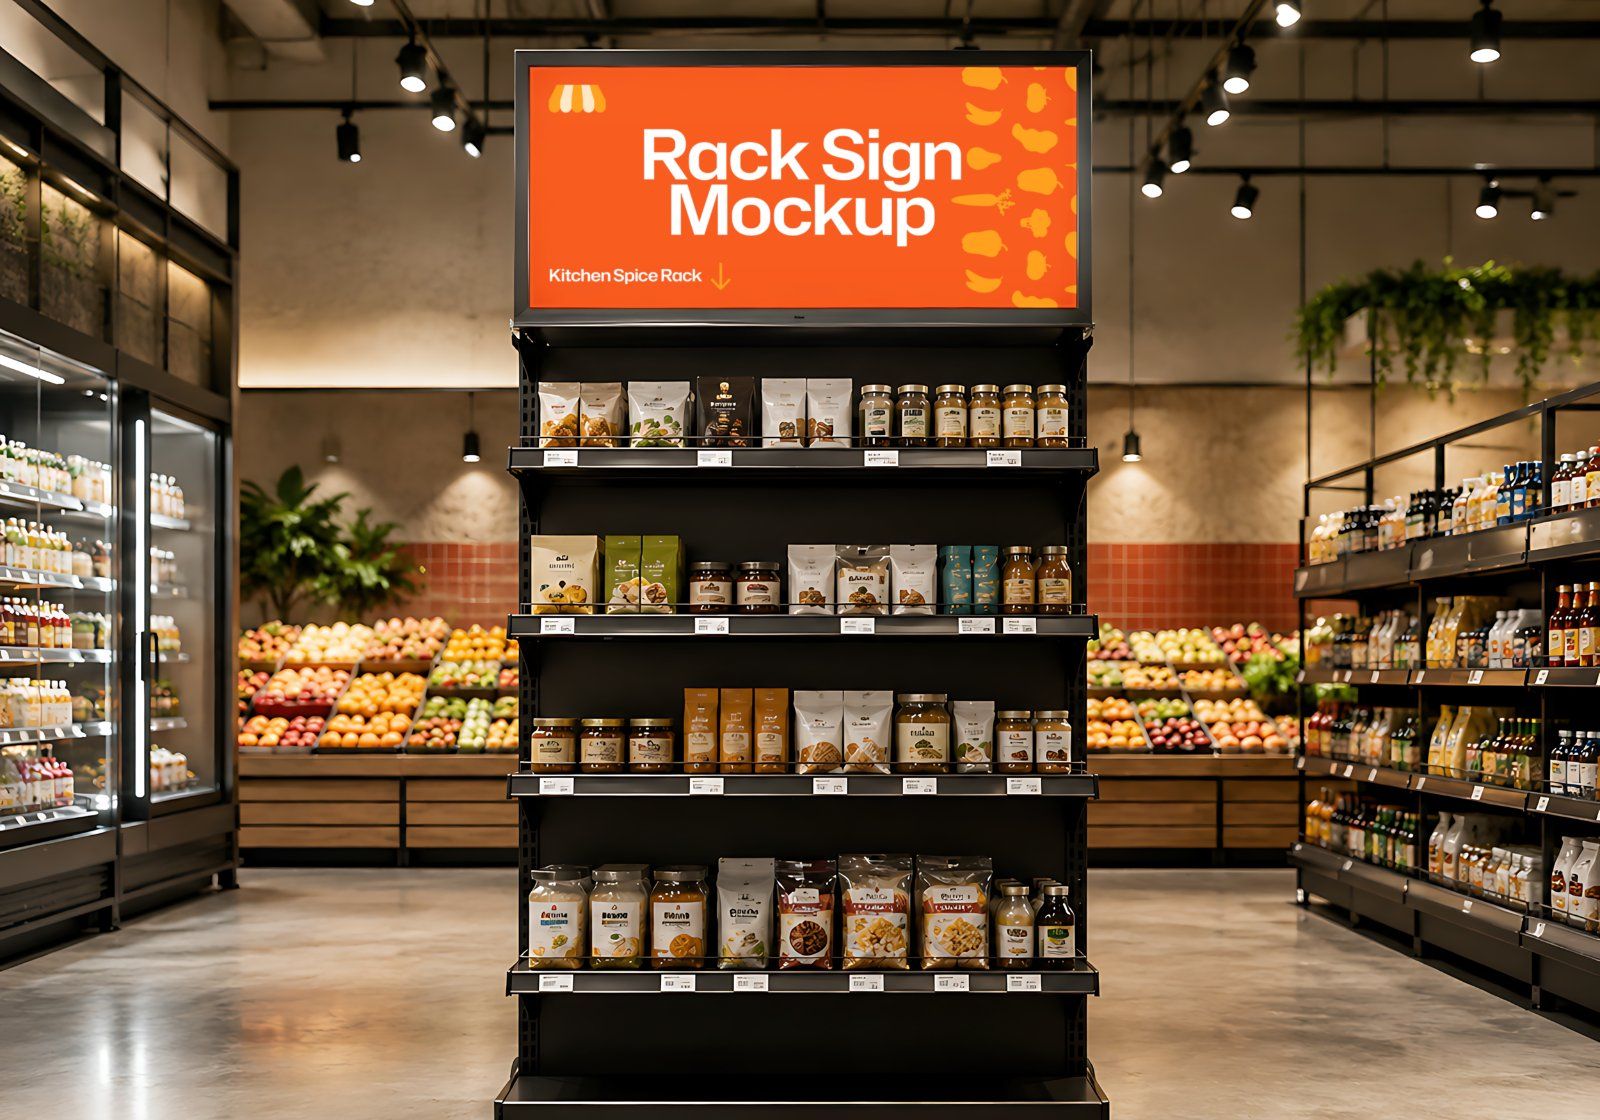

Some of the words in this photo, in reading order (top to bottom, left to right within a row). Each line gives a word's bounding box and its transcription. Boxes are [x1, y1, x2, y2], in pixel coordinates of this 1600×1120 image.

[644, 128, 810, 181] Rack
[823, 128, 962, 192] Sign
[671, 185, 935, 247] Mockup
[549, 268, 611, 282] Kitchen
[613, 268, 659, 285] Spice
[660, 268, 702, 282] Rack
